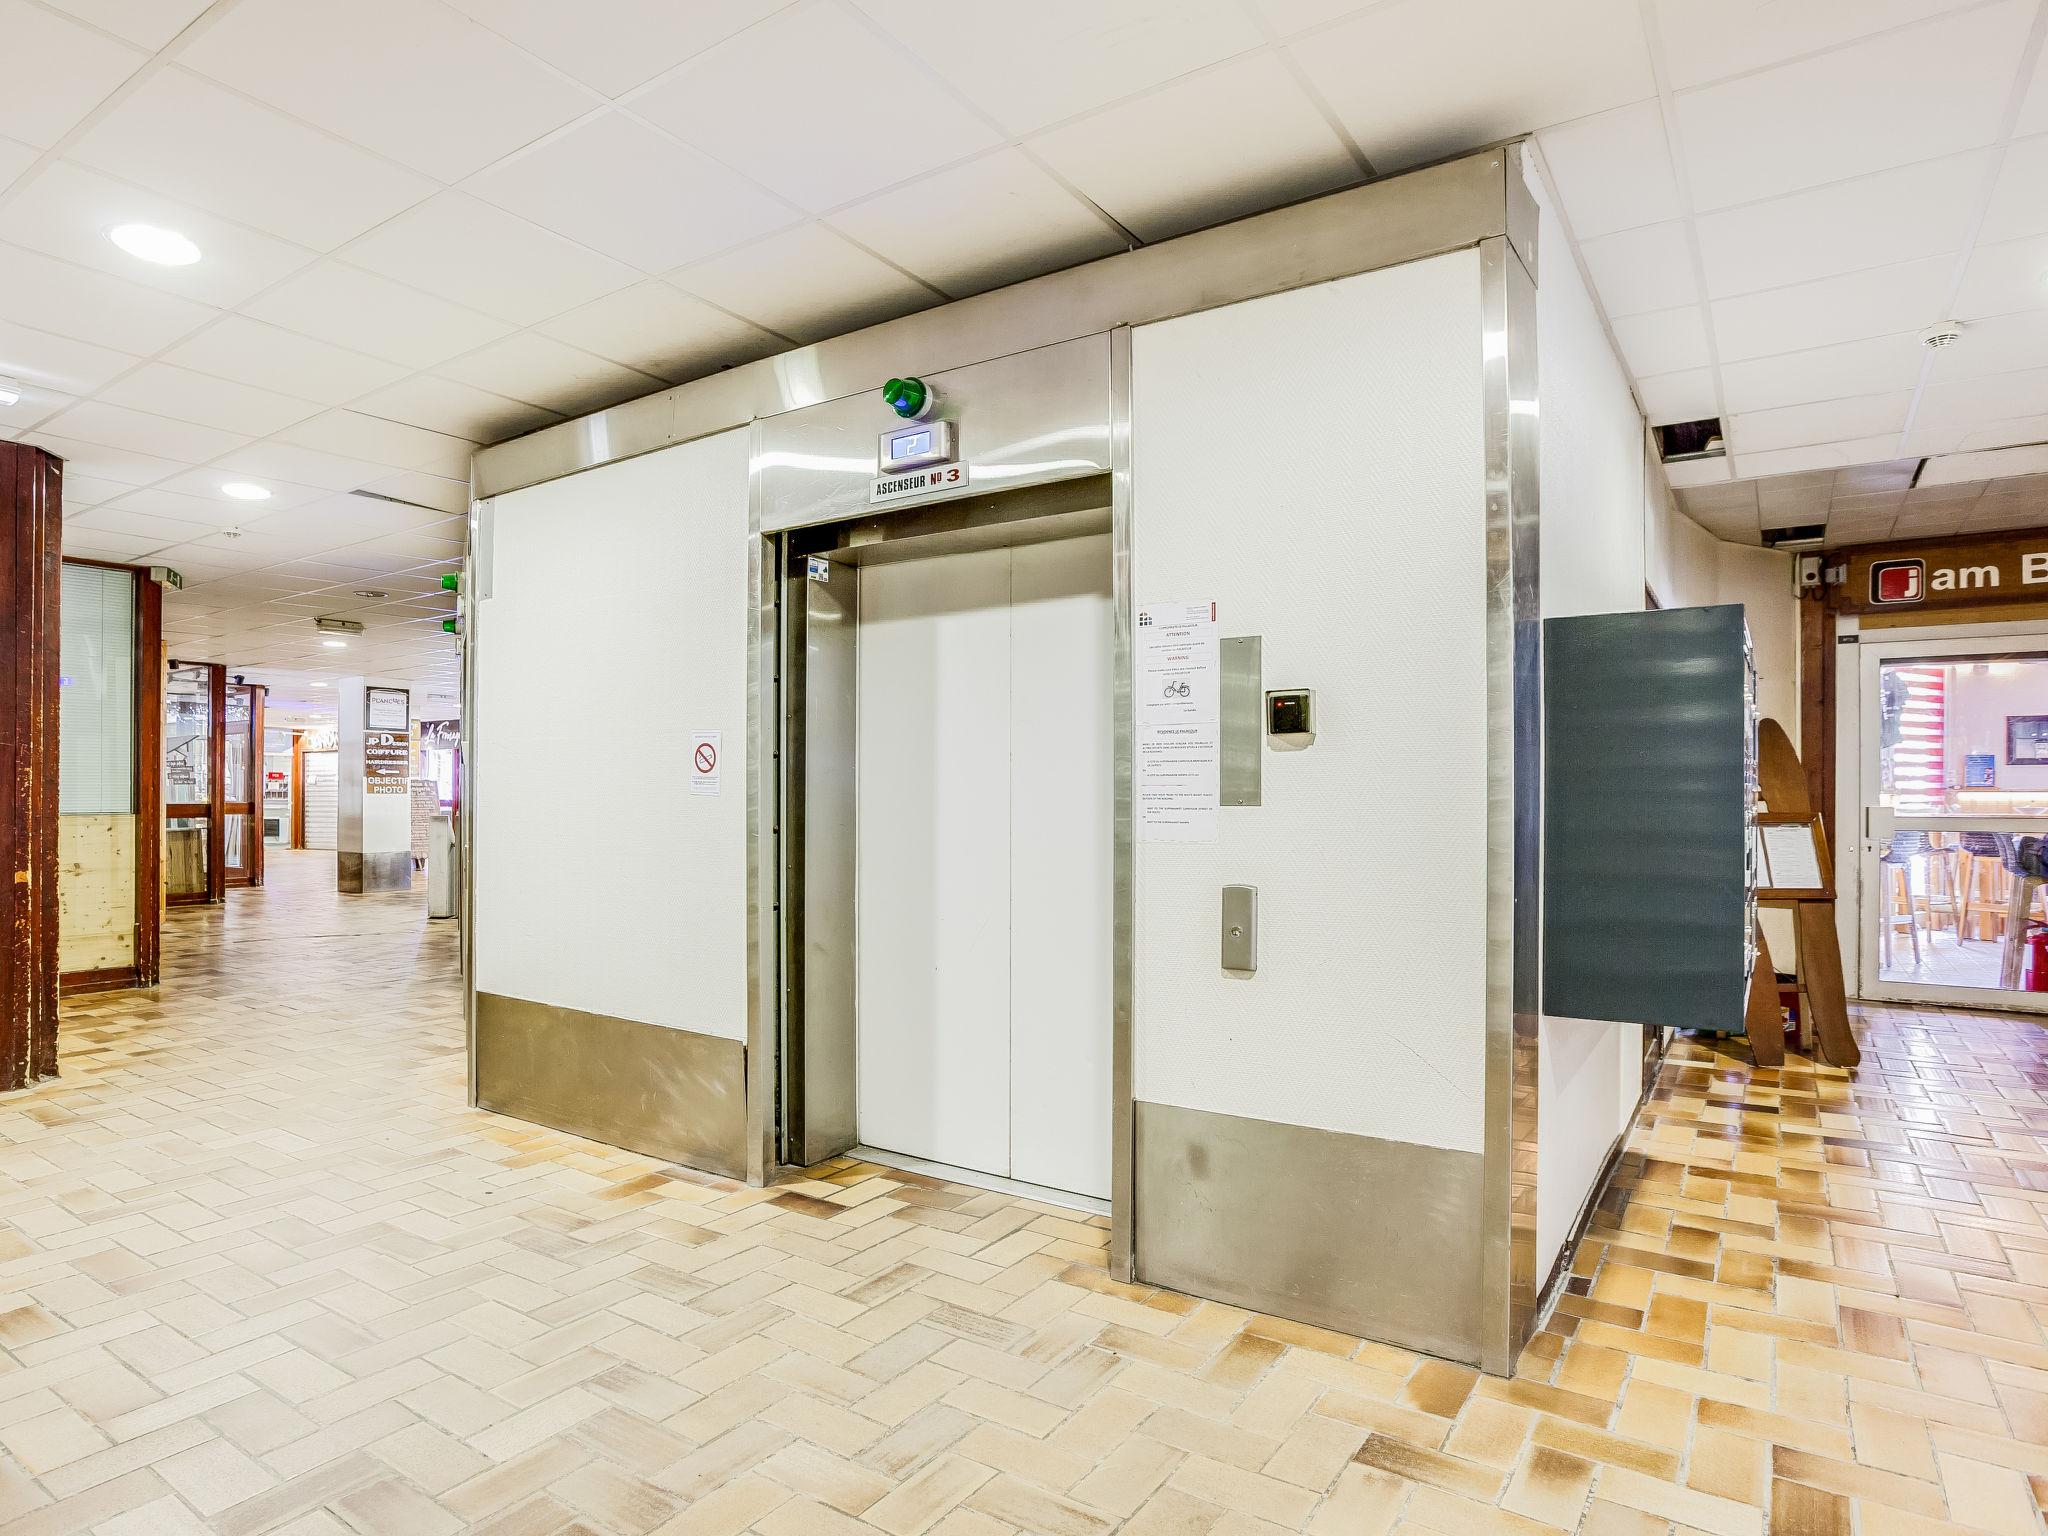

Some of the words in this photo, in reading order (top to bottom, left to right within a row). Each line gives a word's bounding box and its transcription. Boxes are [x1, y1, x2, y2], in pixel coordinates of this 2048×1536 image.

[907, 436, 918, 455] 2
[876, 475, 926, 496] ASCENSEUR
[946, 468, 960, 482] 3
[366, 737, 379, 746] JP
[368, 777, 410, 785] OBJECTIF
[373, 786, 404, 794] PHOTO
